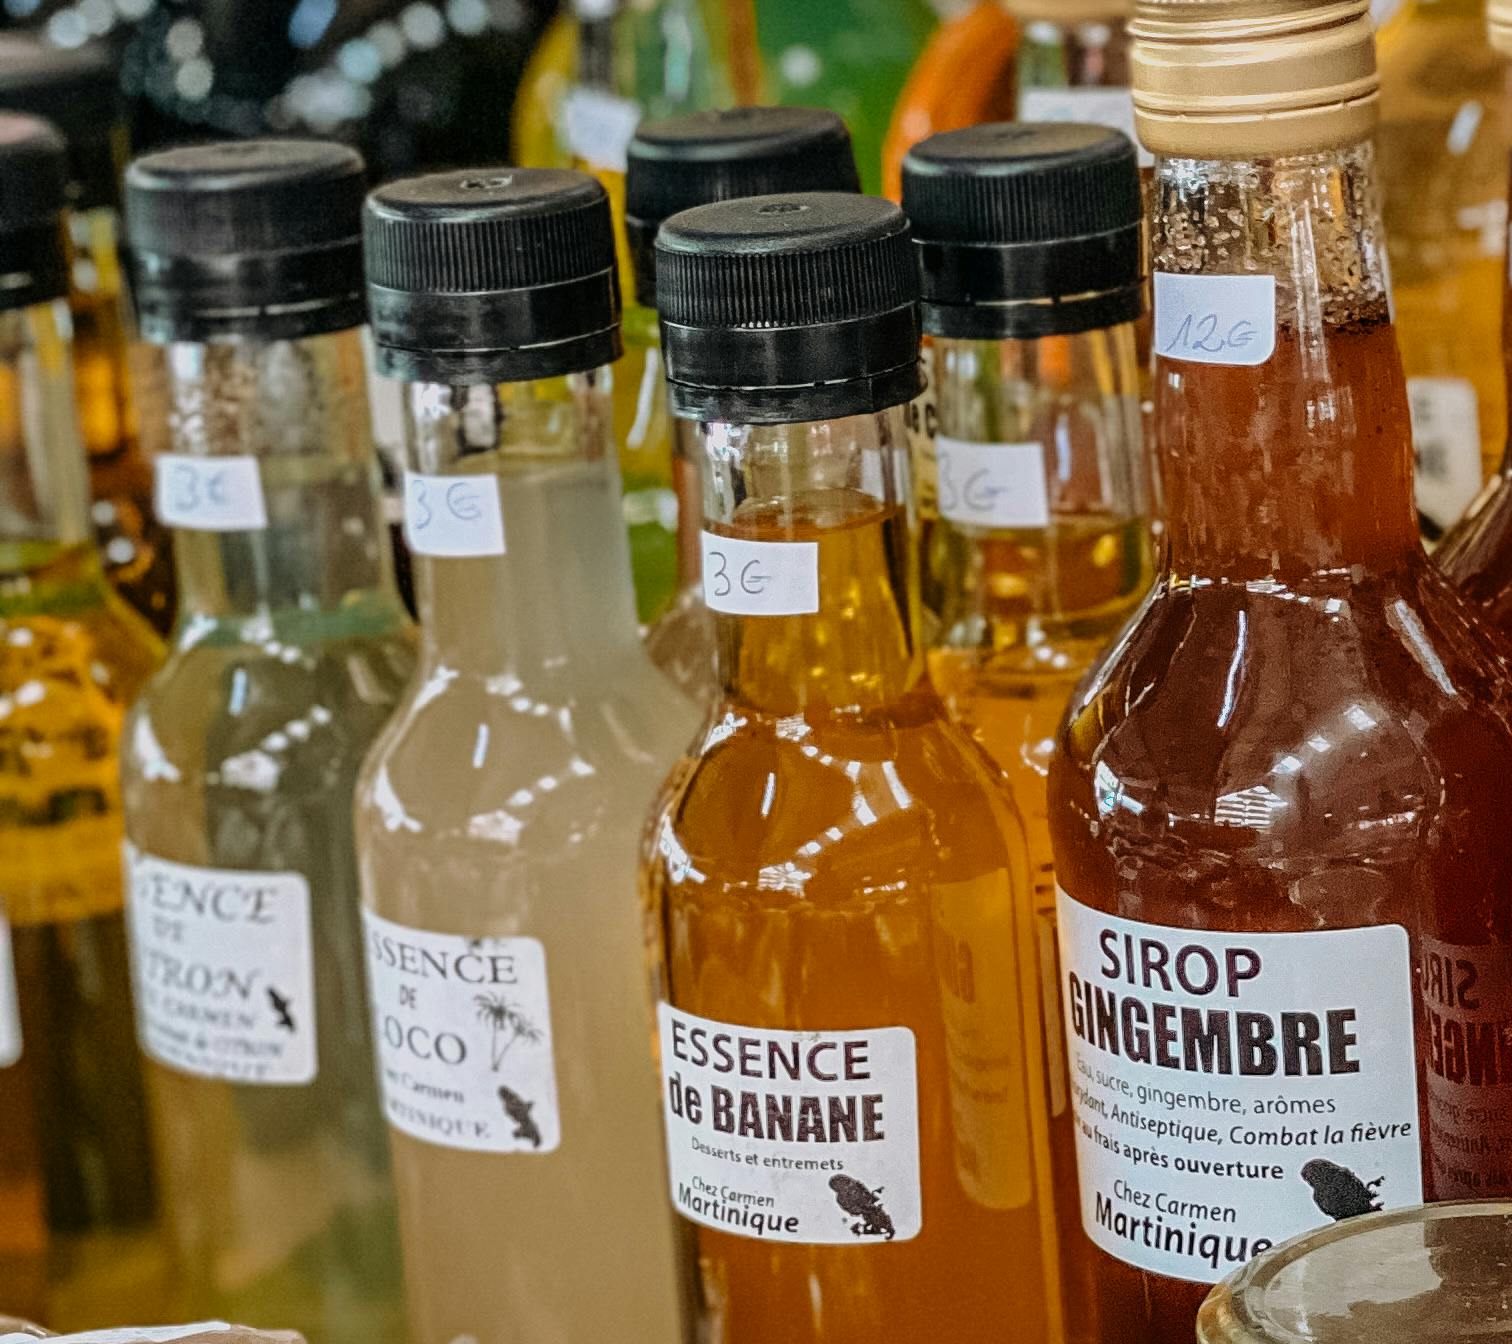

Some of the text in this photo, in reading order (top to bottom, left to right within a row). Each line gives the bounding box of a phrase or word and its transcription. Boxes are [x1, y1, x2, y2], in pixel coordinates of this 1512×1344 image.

[1165, 313, 1258, 353] 12€
[708, 551, 771, 597] 3€
[141, 874, 278, 924] ENCE
[147, 948, 263, 998] TRON
[372, 931, 518, 985] SSENCE
[1099, 928, 1262, 998] SIROP
[385, 1015, 468, 1066] OCO
[1068, 971, 1361, 1076] GINGEMBRE
[671, 1018, 871, 1081] ESSENCE
[668, 1071, 885, 1143] de BANANE
[1096, 1070, 1134, 1098] sucre,
[1137, 1082, 1247, 1115] gingembre,
[1253, 1085, 1336, 1115] arômes
[1111, 1104, 1223, 1145] Antiseptique,
[1229, 1124, 1317, 1147] Combat
[1324, 1124, 1344, 1145] la
[1350, 1120, 1412, 1143] fièvre
[691, 1135, 844, 1171] Desserts et entremets
[1094, 1125, 1120, 1154] frais
[1123, 1144, 1168, 1168] après
[1174, 1156, 1285, 1180] ouverture
[678, 1183, 799, 1235] Martinique
[692, 1176, 775, 1208] Chez Carmen
[1113, 1180, 1236, 1223] Chez Carmen
[1095, 1191, 1274, 1269] Martinique
